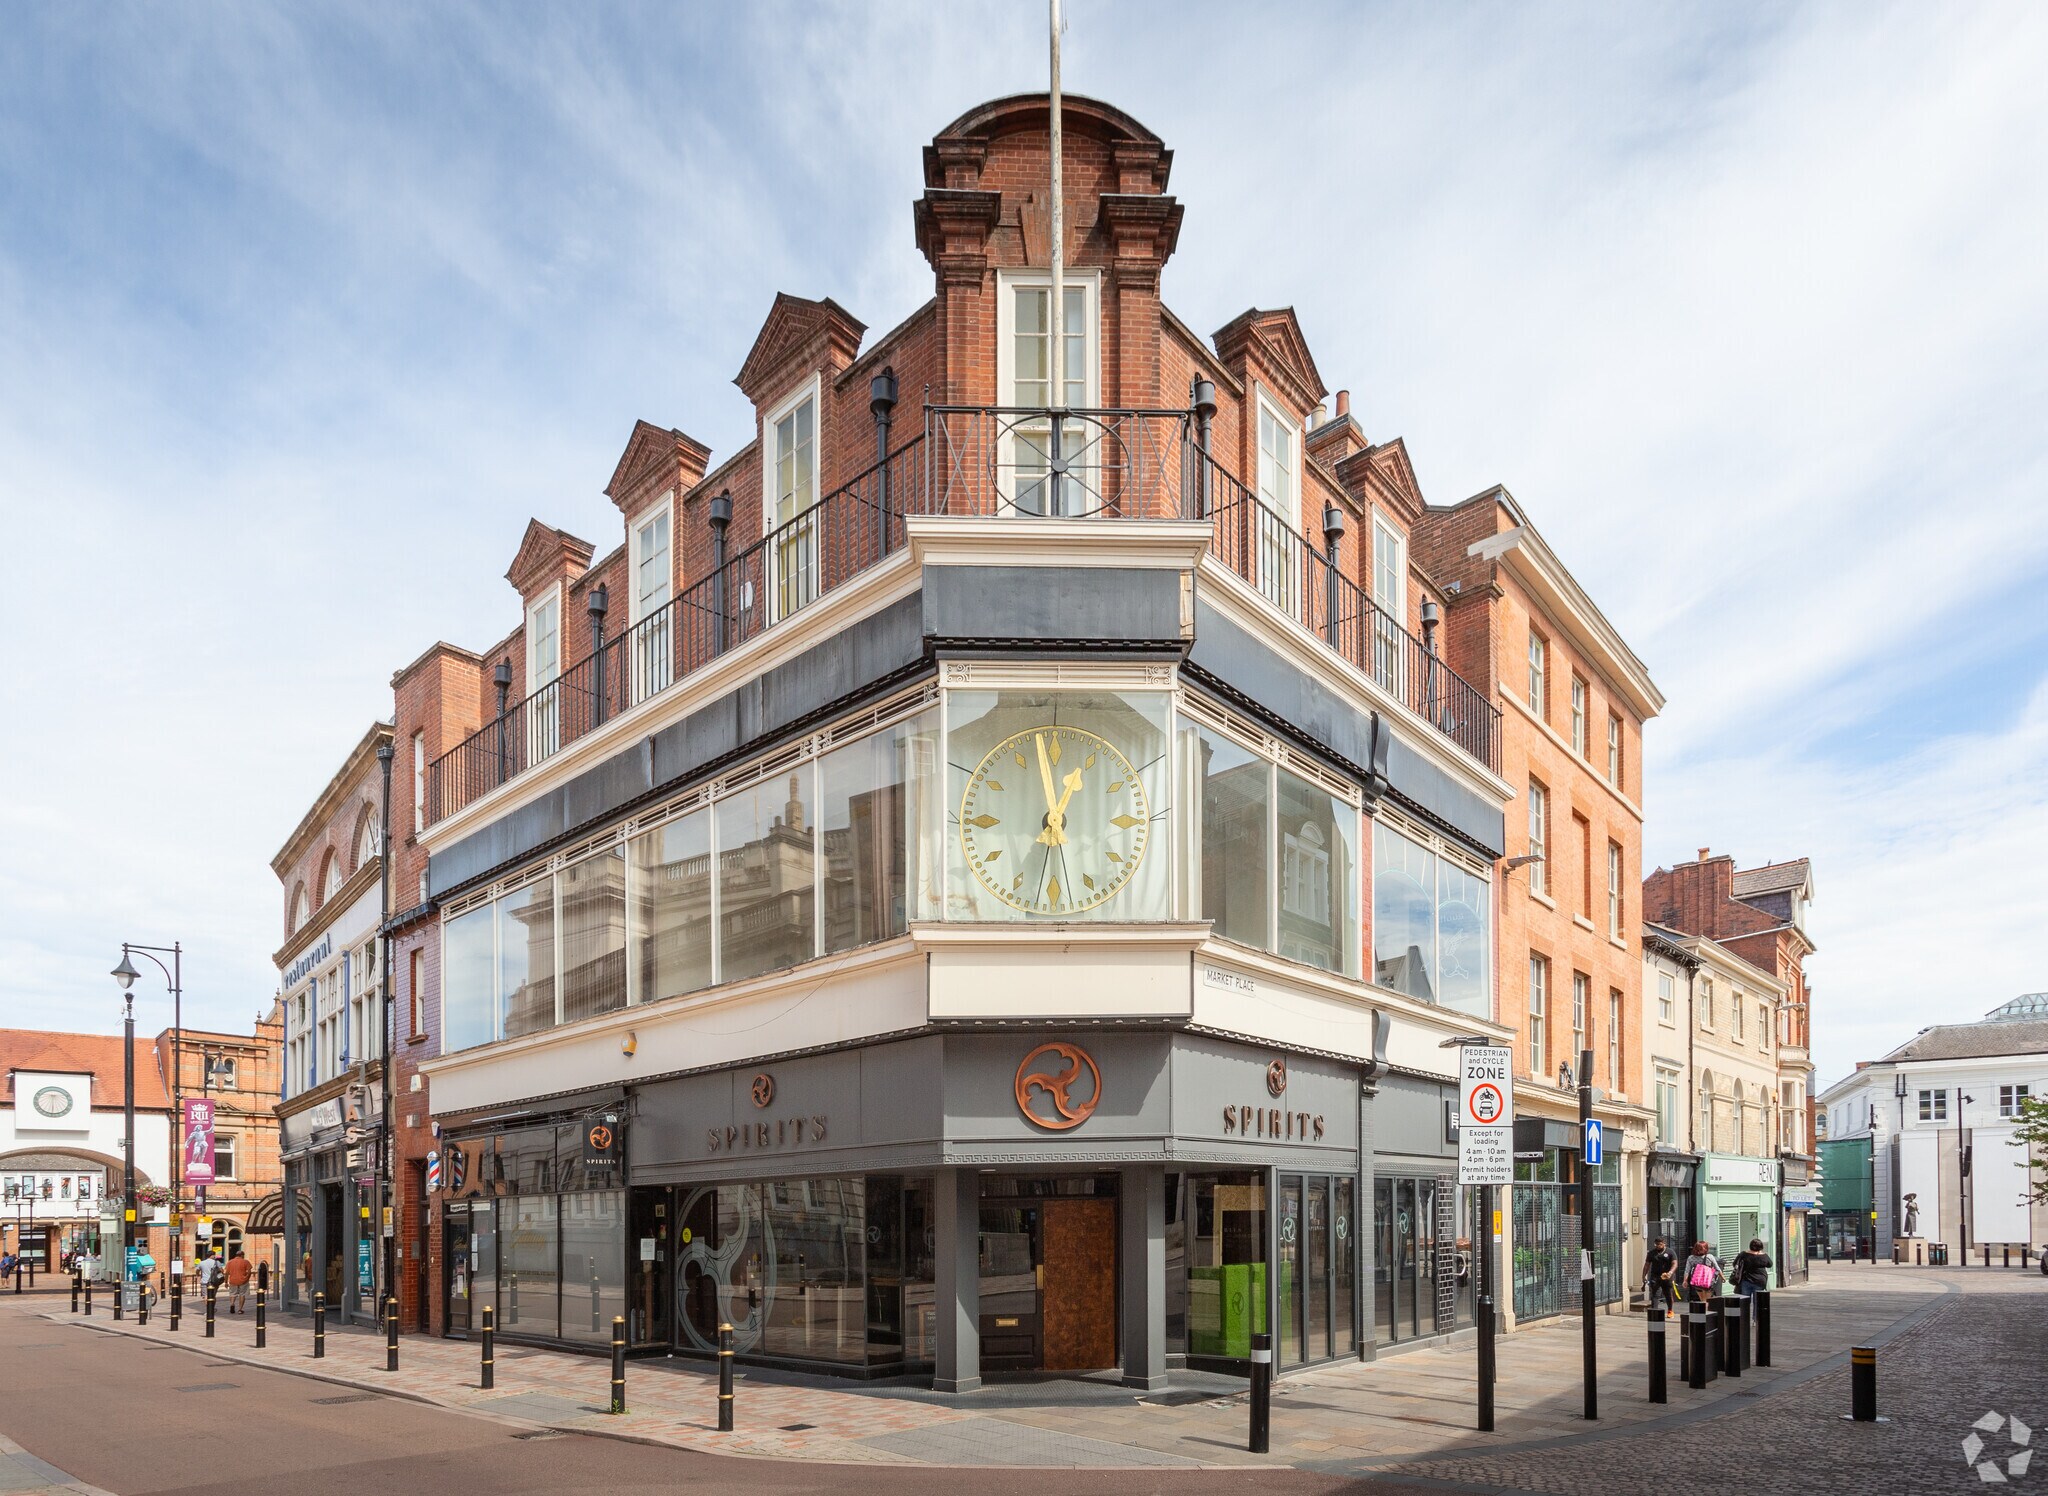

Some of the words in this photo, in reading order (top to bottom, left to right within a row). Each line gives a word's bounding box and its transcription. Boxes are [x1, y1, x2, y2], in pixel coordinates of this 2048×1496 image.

[1207, 969, 1233, 986] MARKET
[1236, 977, 1254, 992] PLACE
[1465, 1048, 1508, 1057] PEDESTRIAN
[1482, 1057, 1504, 1065] CYCLE
[1467, 1066, 1505, 1079] ZONE
[1223, 1104, 1325, 1141] SPIRITS
[707, 1115, 826, 1151] SPIRITS
